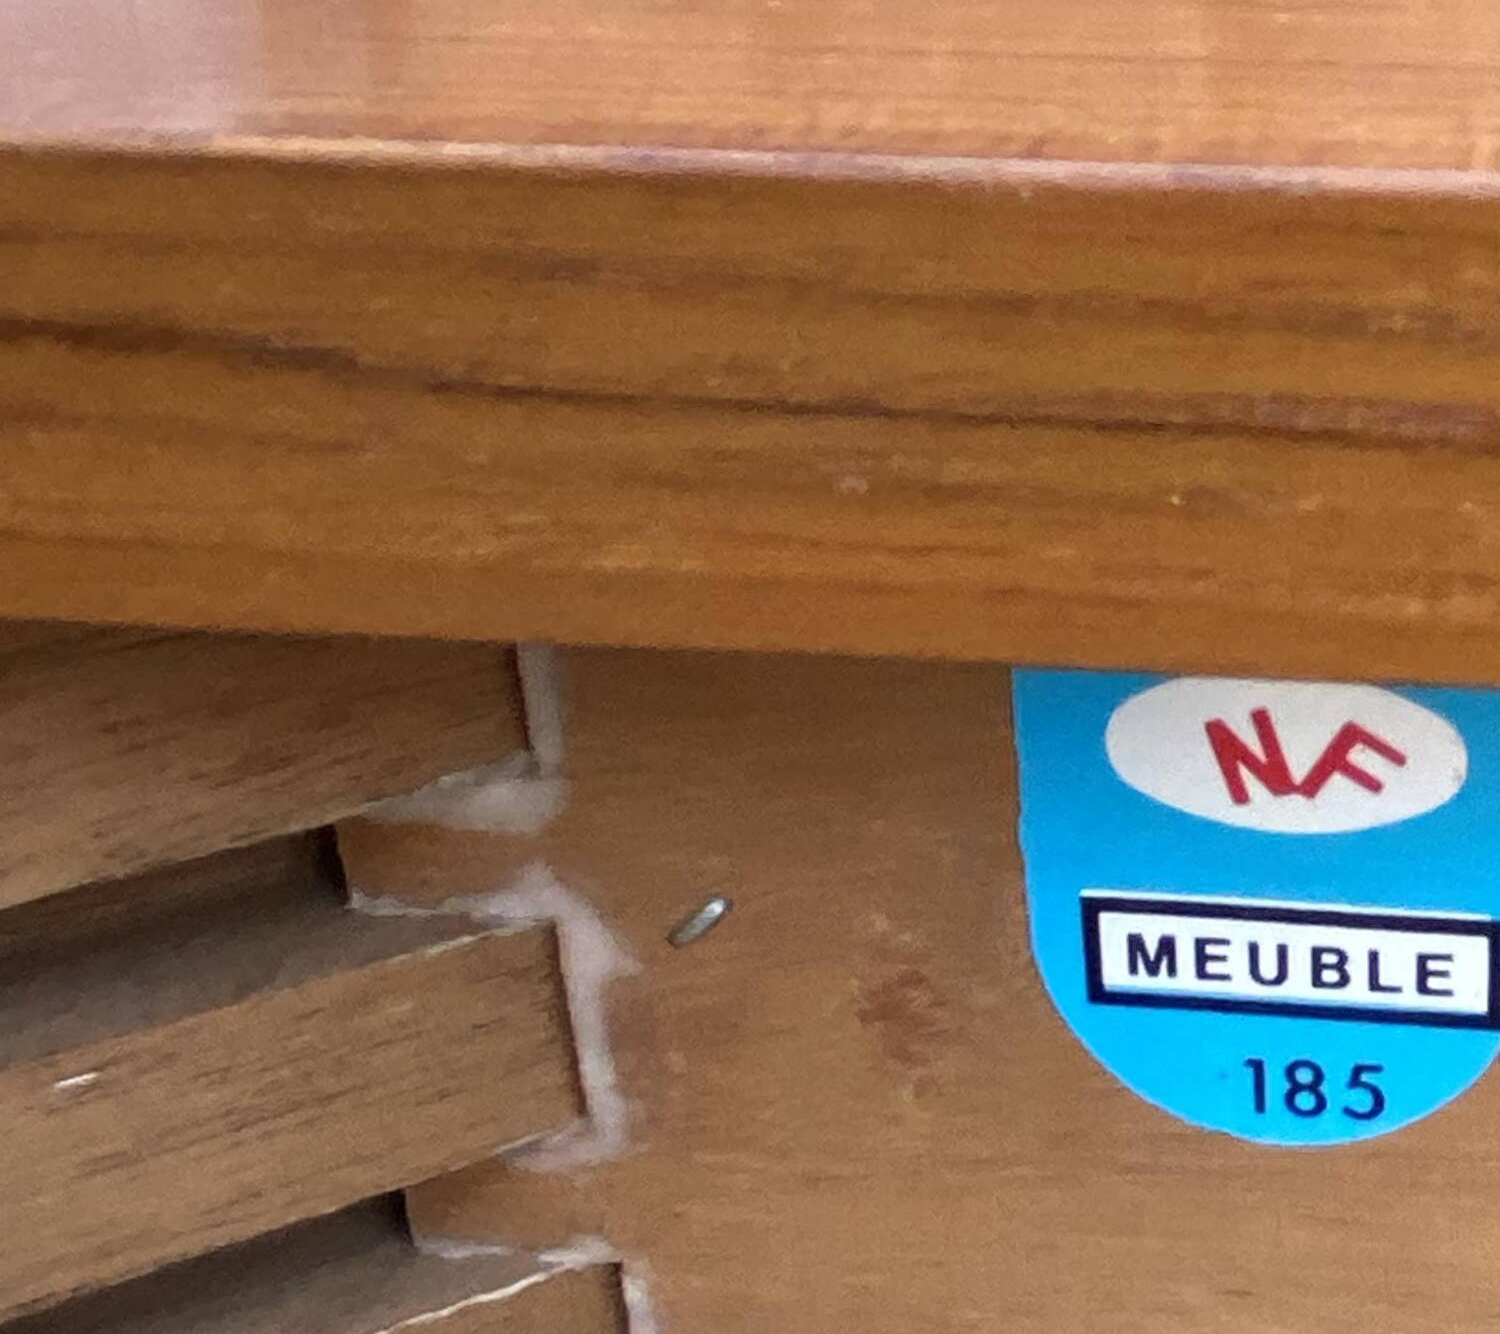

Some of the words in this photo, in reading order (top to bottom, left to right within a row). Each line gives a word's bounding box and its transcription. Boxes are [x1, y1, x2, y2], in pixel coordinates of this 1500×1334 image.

[1205, 706, 1407, 805] NF
[1126, 933, 1455, 998] MEUBLE
[1244, 1058, 1386, 1121] 185
